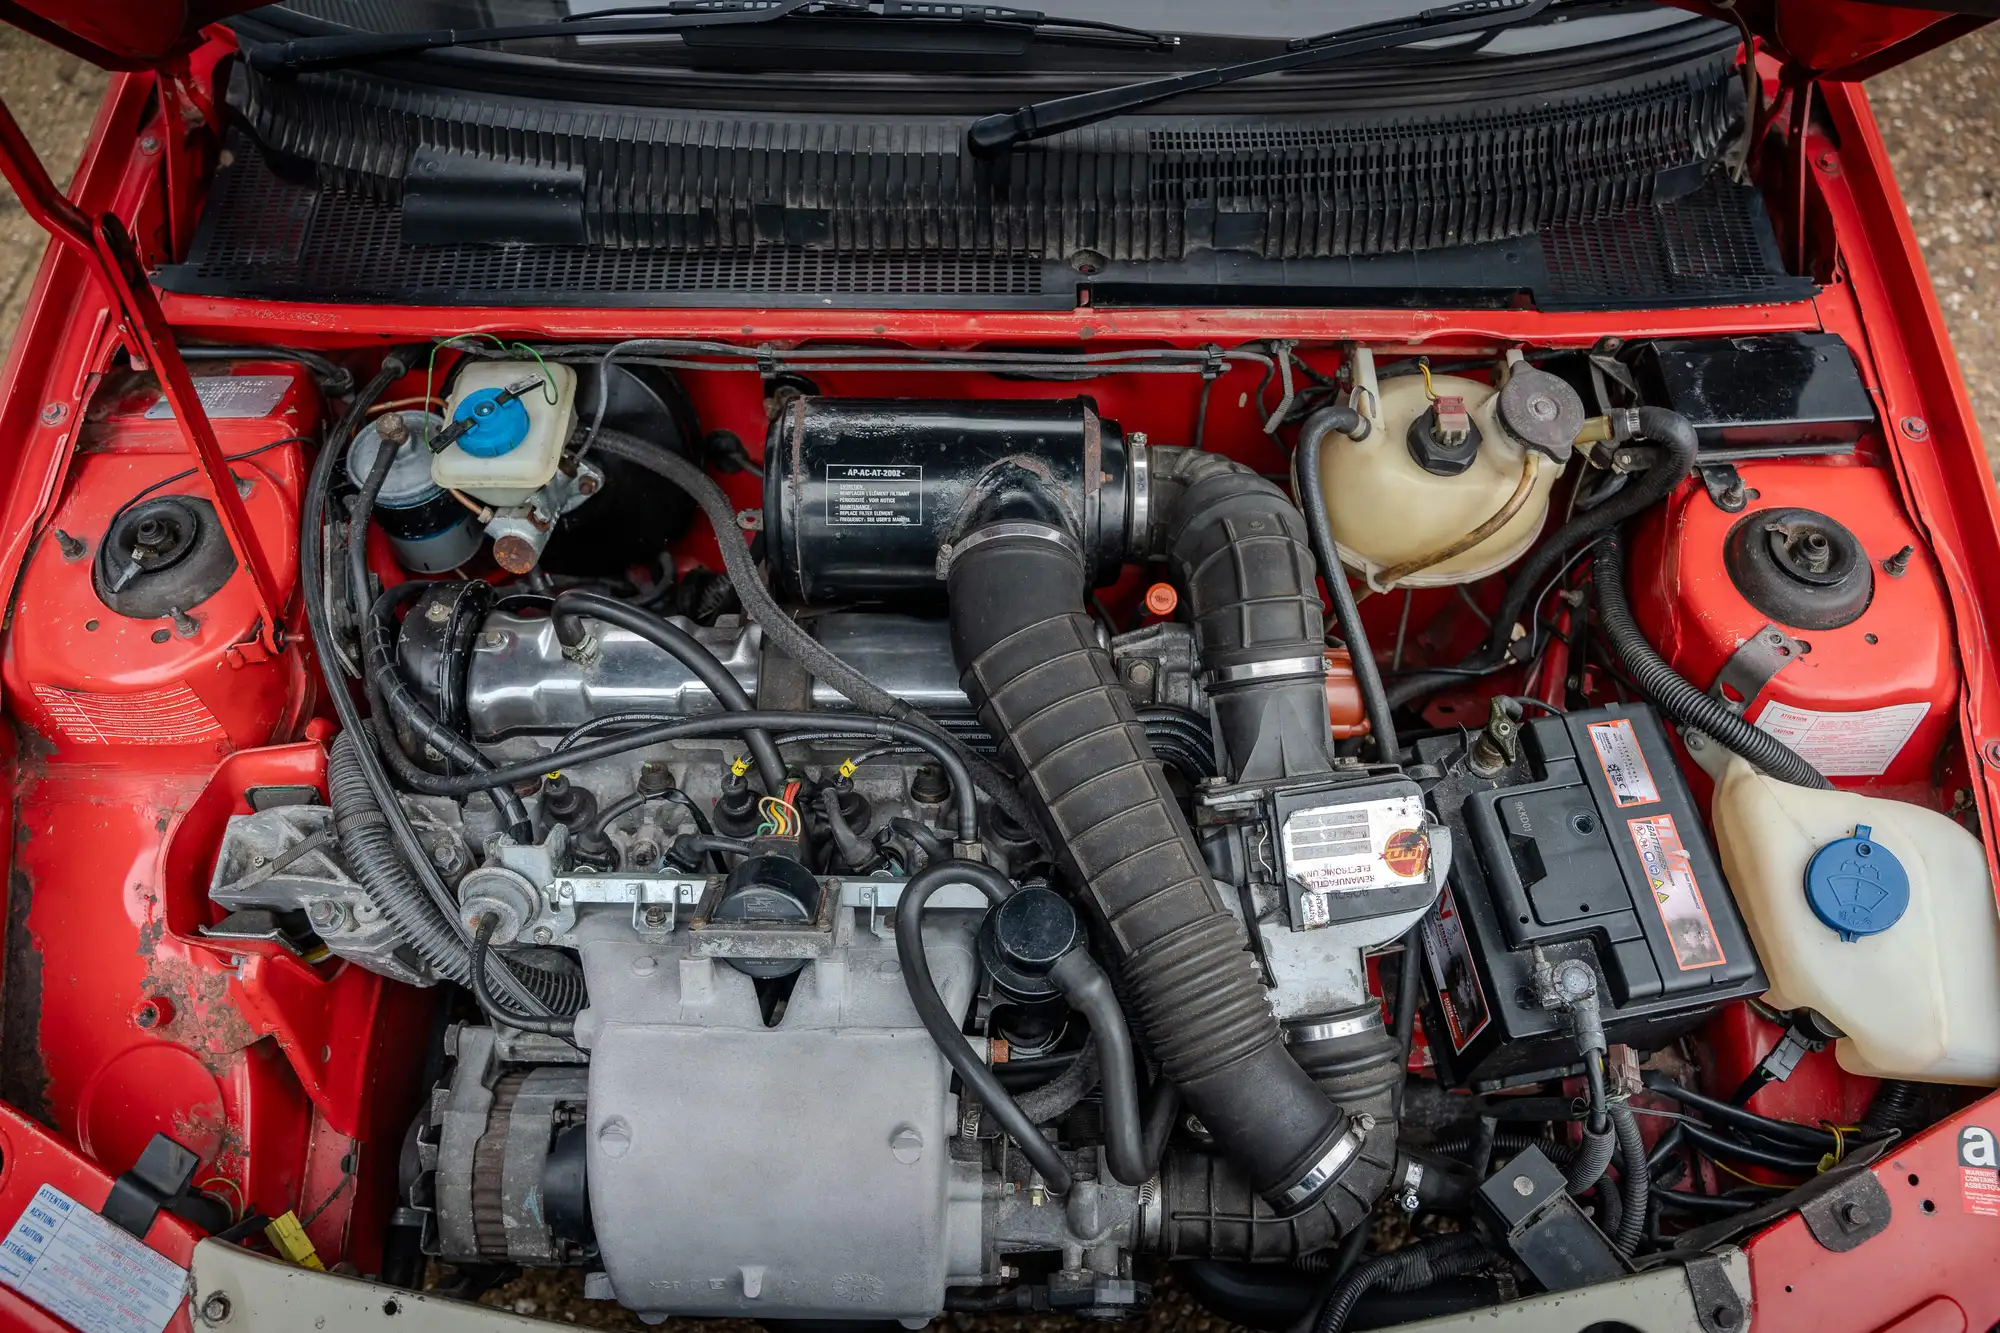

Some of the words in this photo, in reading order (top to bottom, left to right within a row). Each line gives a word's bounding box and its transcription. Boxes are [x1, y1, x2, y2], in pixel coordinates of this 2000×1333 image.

[847, 469, 901, 477] AP-AC-AT-2002
[1780, 713, 1807, 722] ATTENTION
[1773, 727, 1794, 736] CAUTION
[1515, 801, 1532, 832] 9KKD01
[1645, 824, 1670, 871] BATTERIES
[1320, 864, 1371, 877] ELECTRONIC
[1963, 1127, 1996, 1166] a
[39, 1188, 72, 1212] ATTENTION
[29, 1207, 57, 1228] ACHTUNG
[19, 1224, 45, 1244] CAUTION
[2, 1239, 37, 1266] ATTENZIONE
